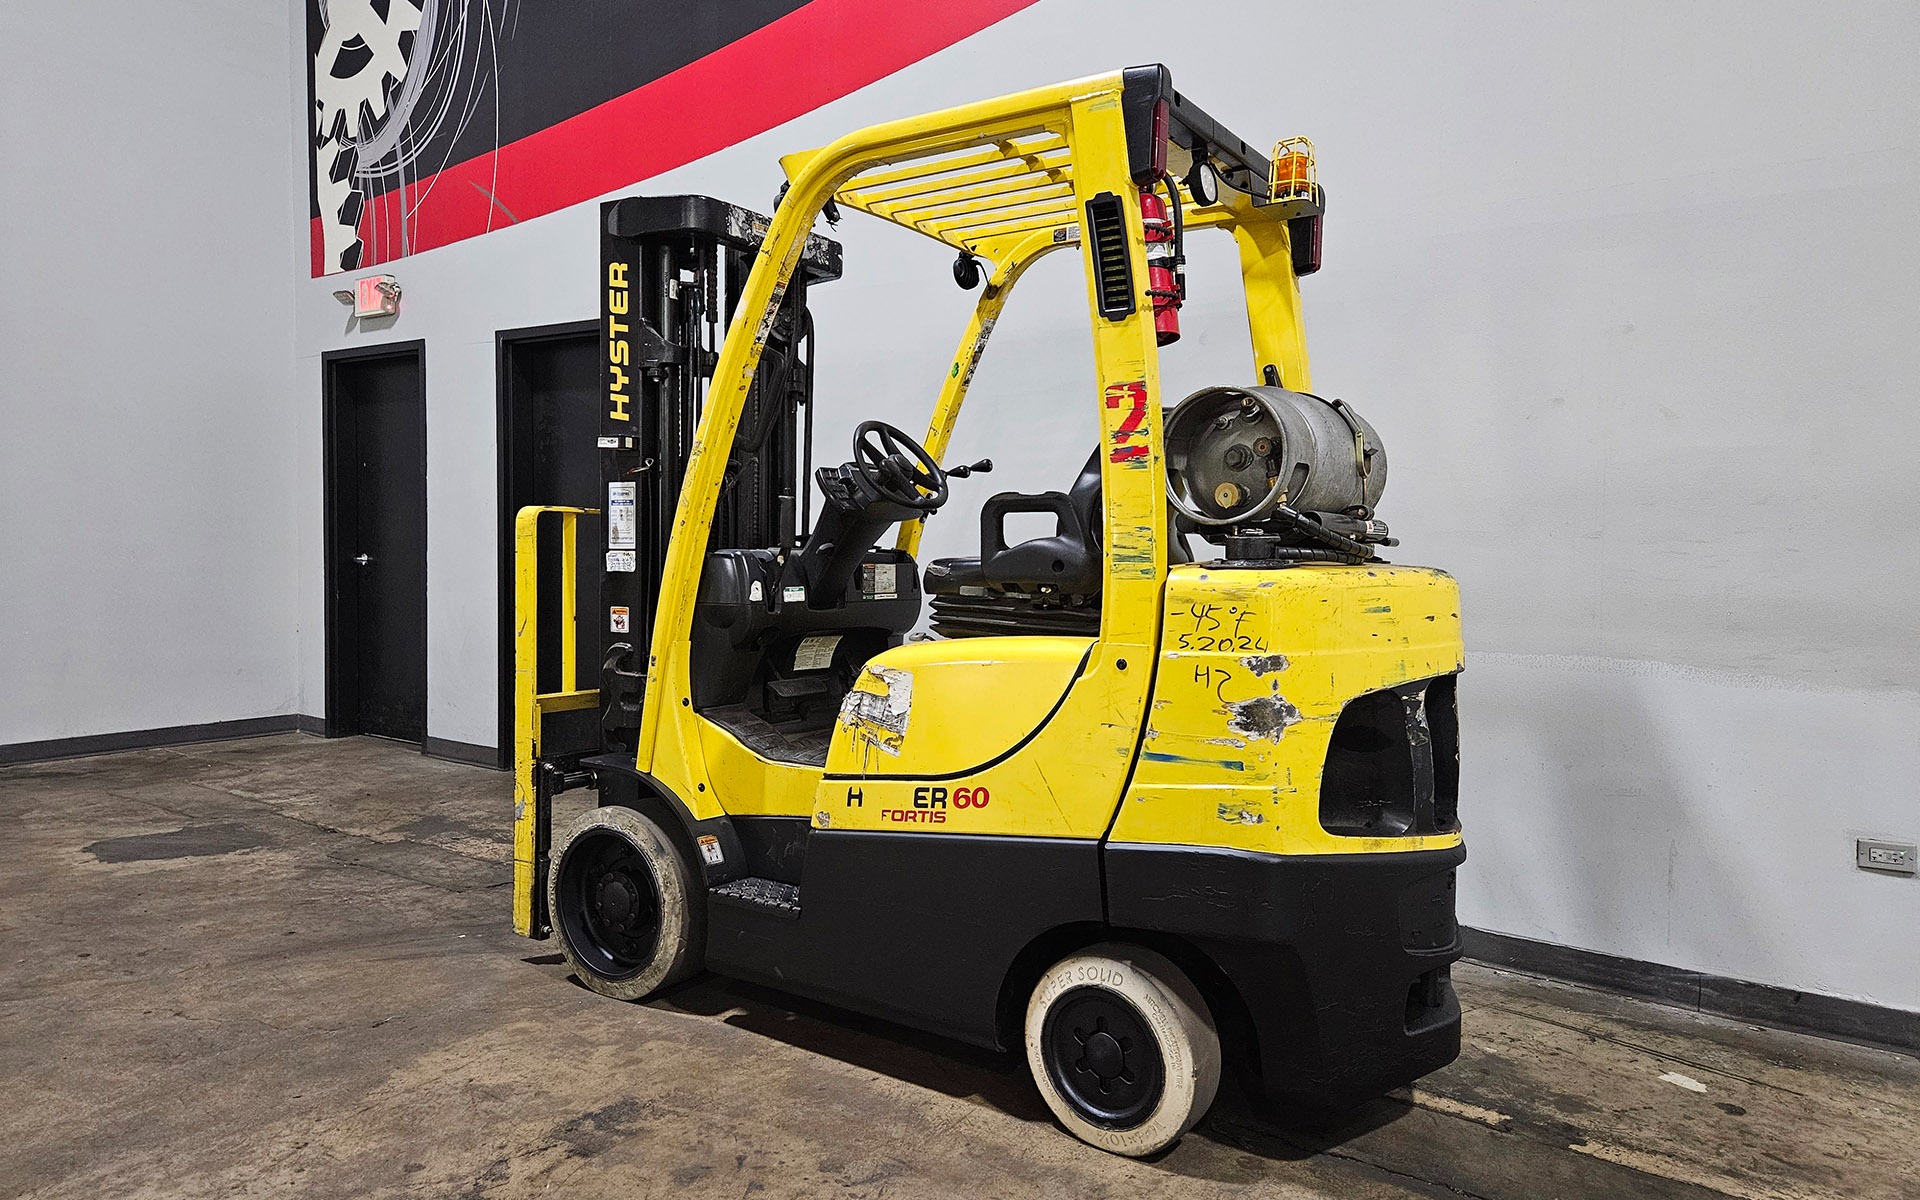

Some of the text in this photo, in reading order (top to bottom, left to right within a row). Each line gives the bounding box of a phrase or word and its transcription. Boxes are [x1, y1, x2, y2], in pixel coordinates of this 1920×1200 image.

[609, 262, 630, 422] HYSTER
[1105, 381, 1149, 463] 2
[881, 809, 947, 824] FORTIS
[952, 786, 990, 809] 60
[1039, 966, 1124, 1009] SUPER SOLID
